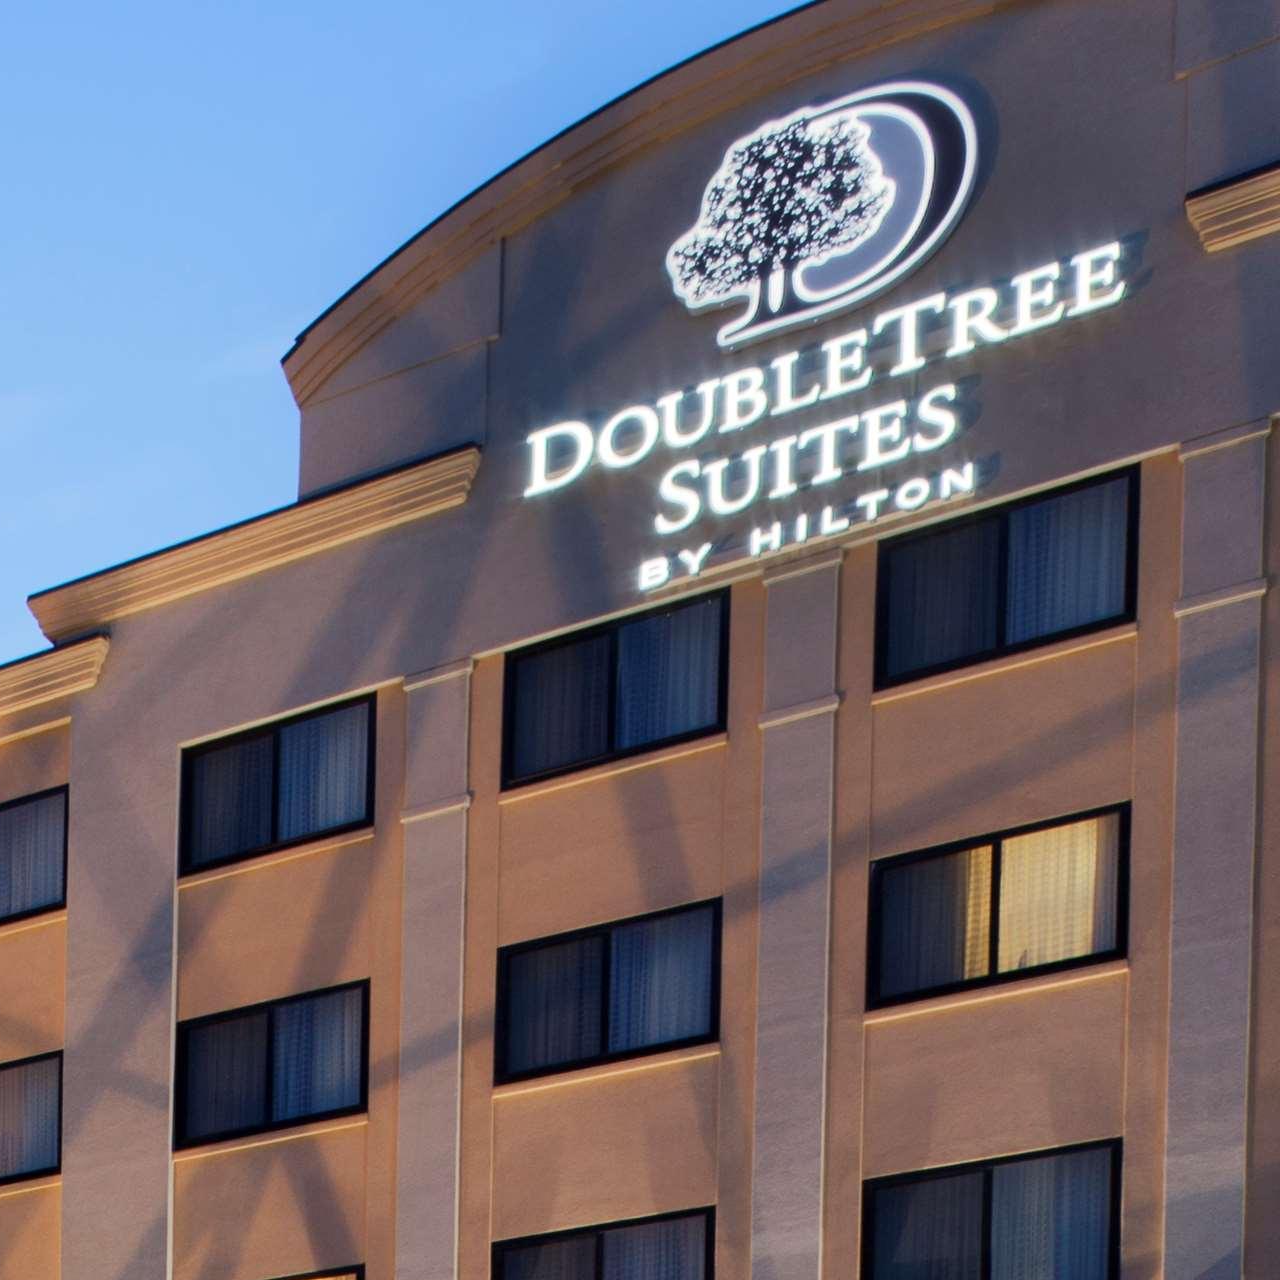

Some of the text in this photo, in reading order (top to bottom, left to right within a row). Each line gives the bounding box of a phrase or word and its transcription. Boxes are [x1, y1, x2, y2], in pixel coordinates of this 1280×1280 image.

[523, 241, 1127, 499] DOUBLETREE
[638, 461, 975, 592] BY HILTON
[653, 383, 957, 535] SUITES
